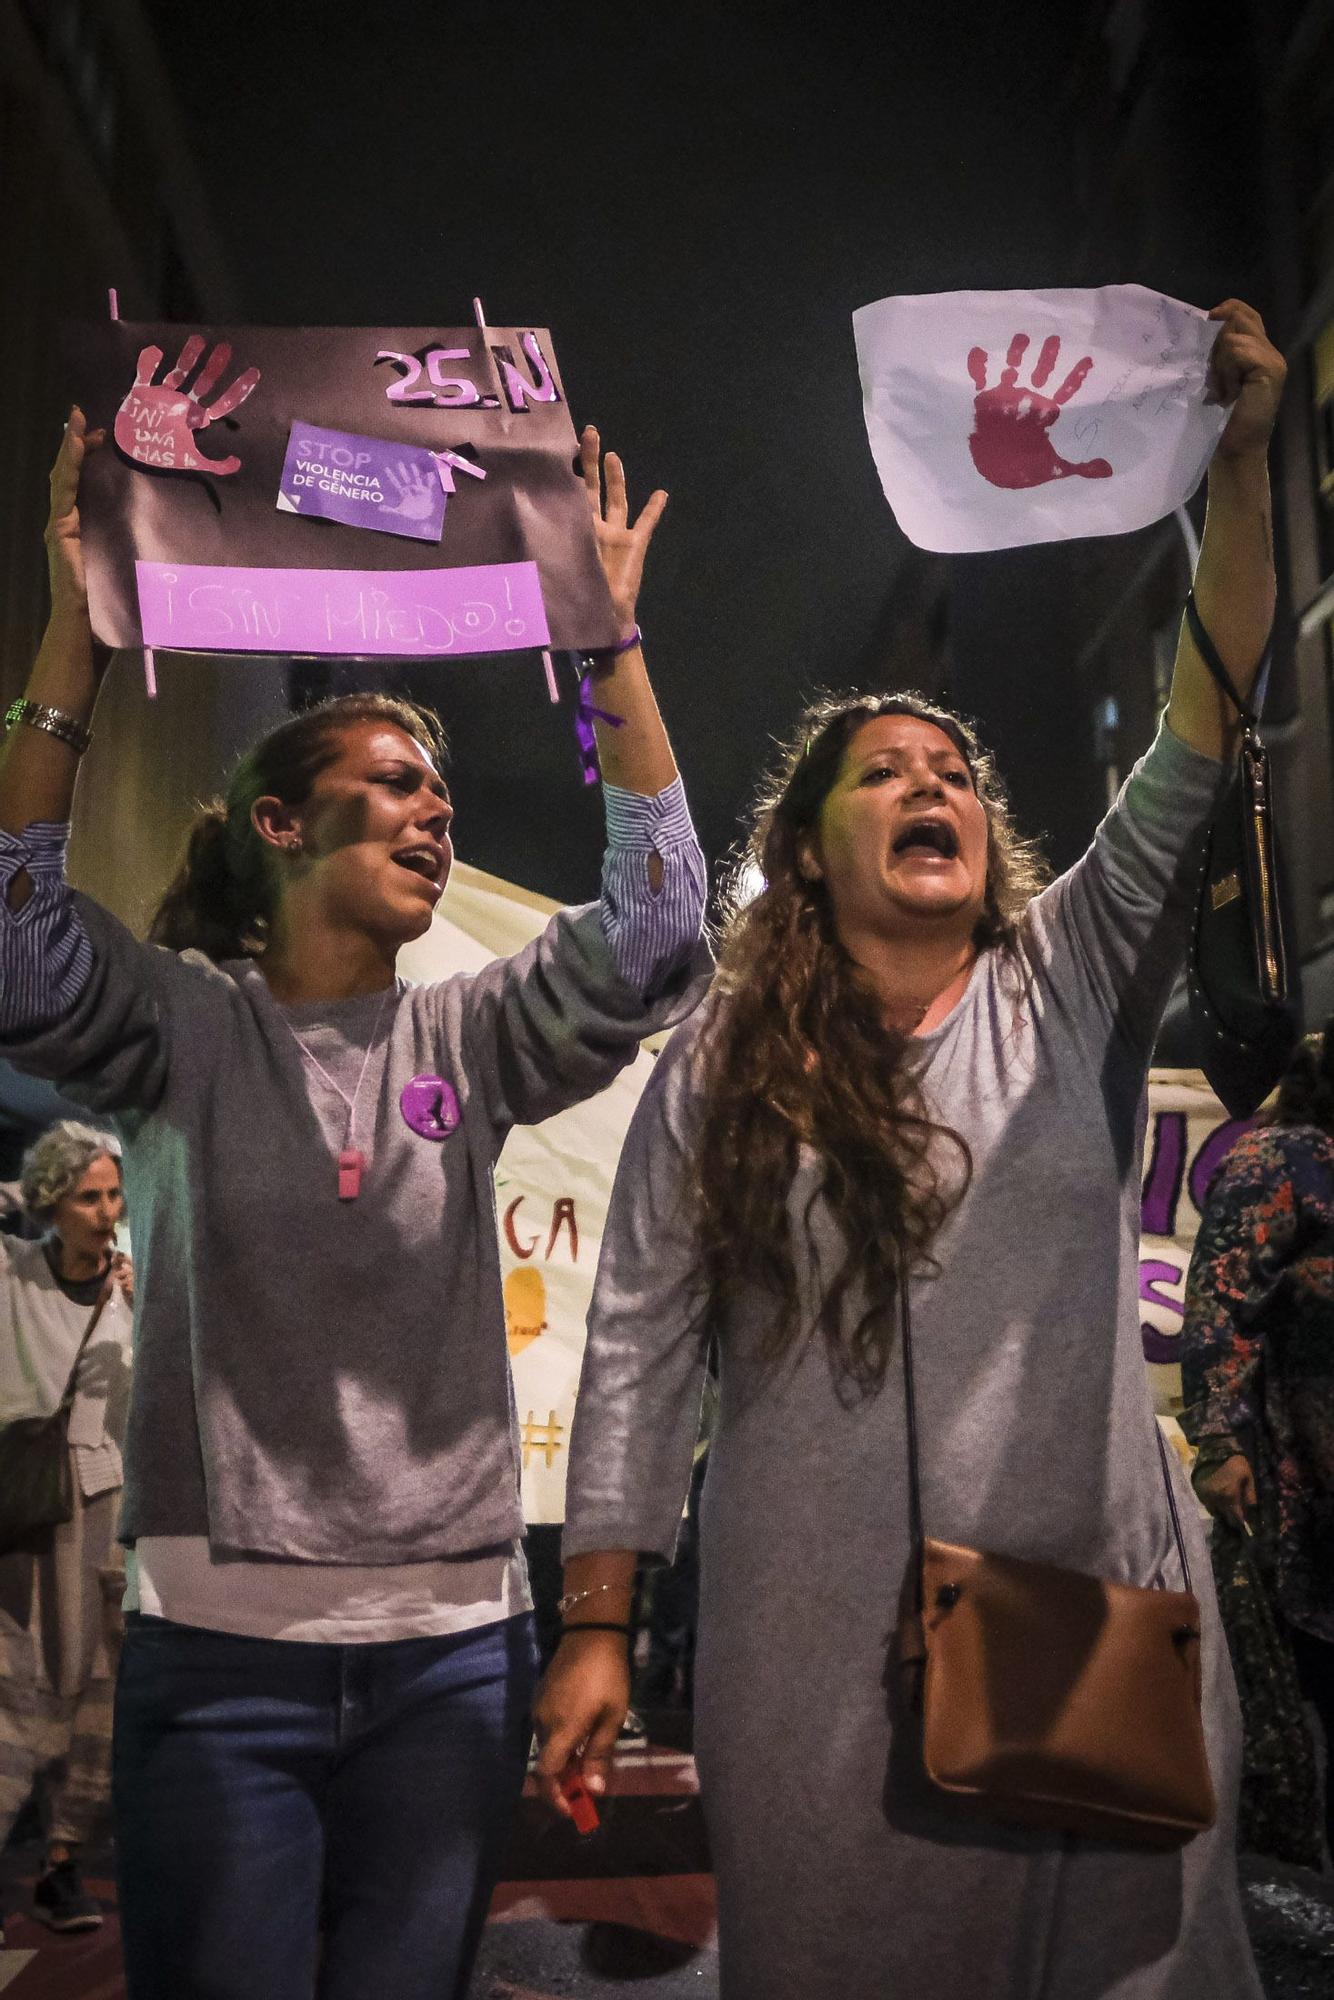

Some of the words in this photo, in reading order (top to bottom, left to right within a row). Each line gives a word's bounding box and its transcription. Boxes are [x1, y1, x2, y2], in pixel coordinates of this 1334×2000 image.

[297, 439, 372, 469] STOP
[292, 474, 315, 487] DE
[318, 478, 384, 503] GÉNERO
[295, 460, 381, 489] VIOLENCIA
